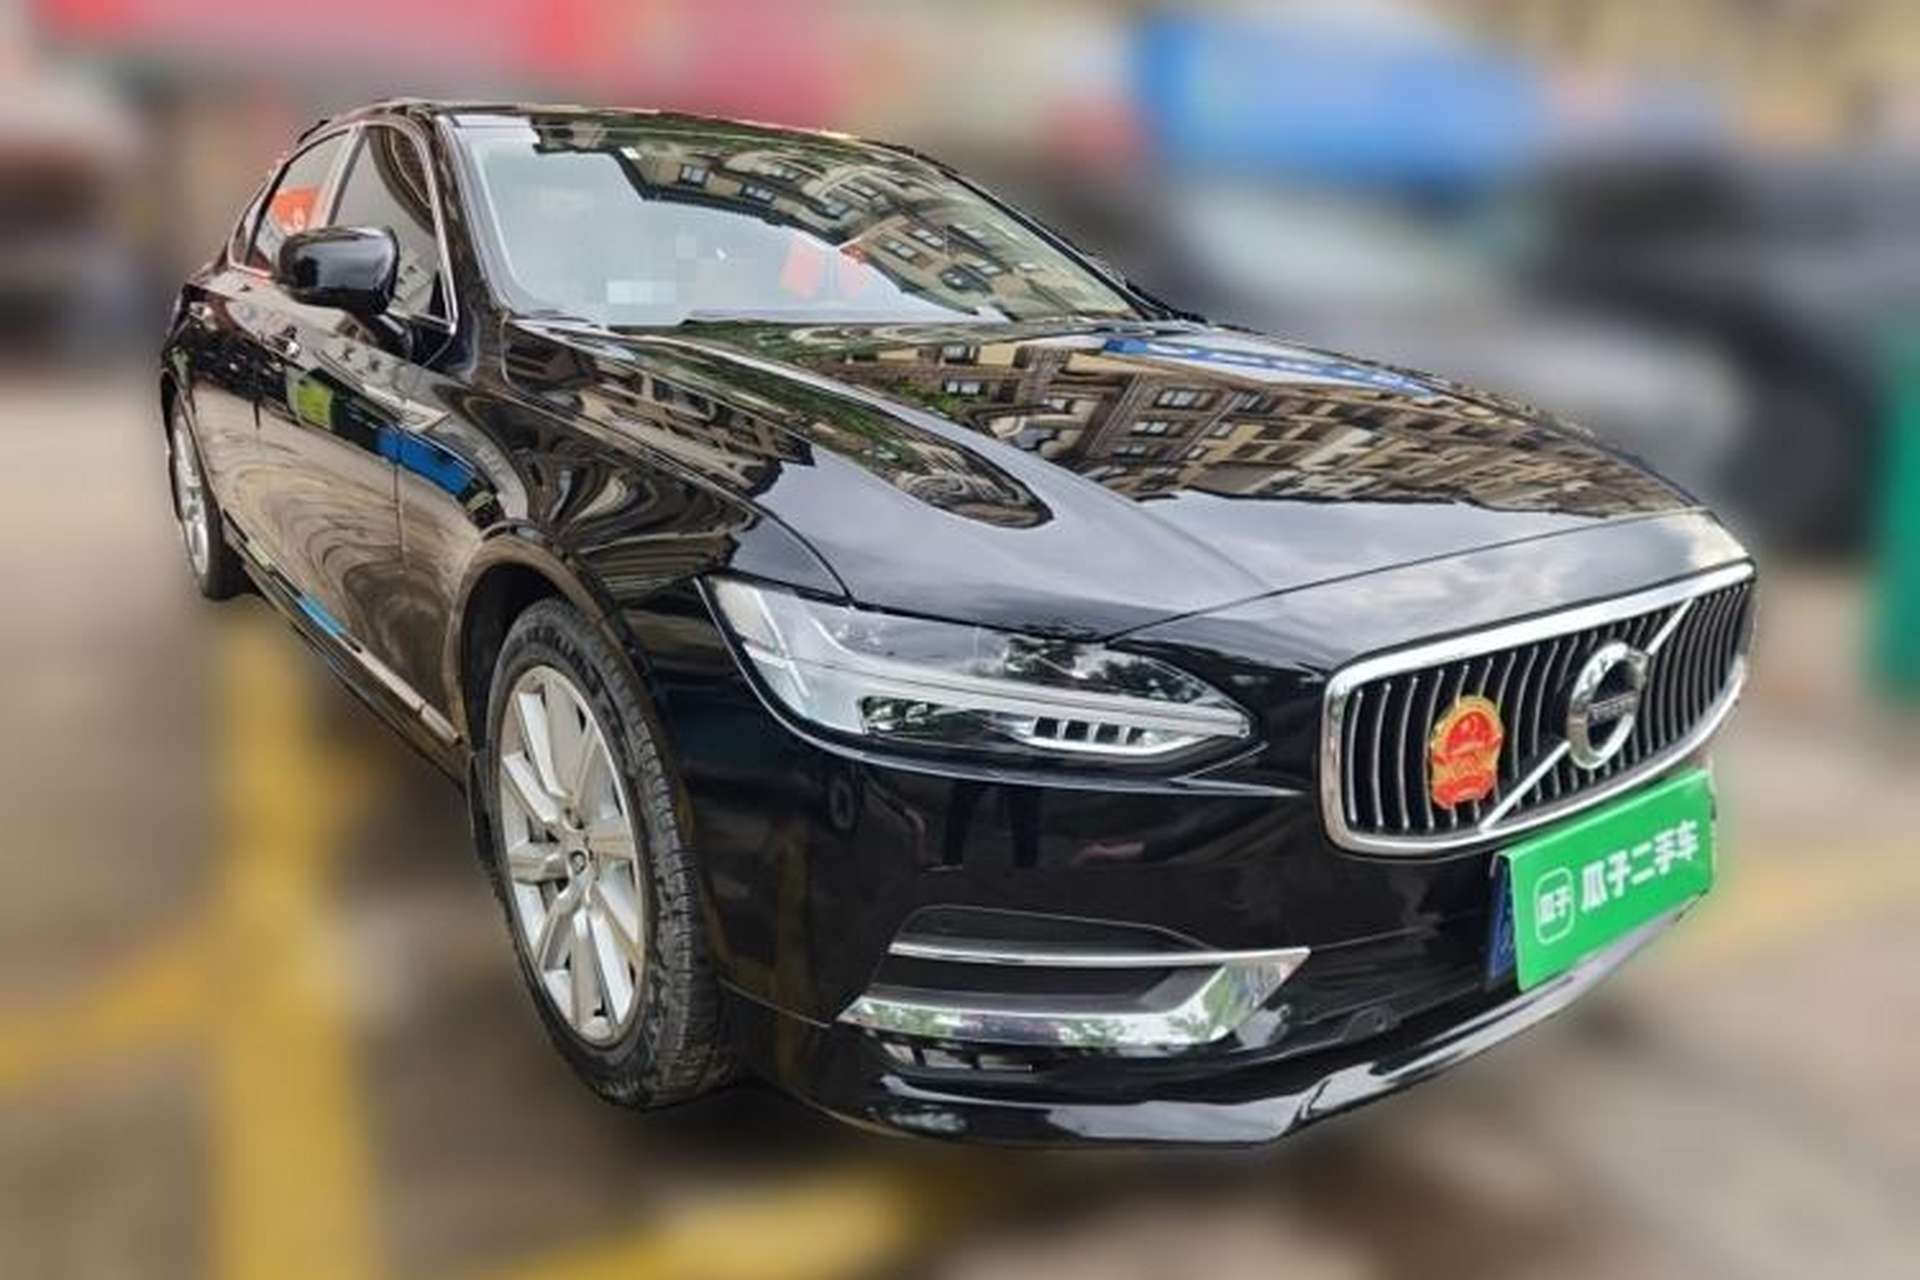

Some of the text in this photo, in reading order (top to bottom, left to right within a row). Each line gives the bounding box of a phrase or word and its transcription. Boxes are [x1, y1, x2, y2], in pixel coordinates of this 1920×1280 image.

[1581, 820, 1699, 913] 瓜子二手车
